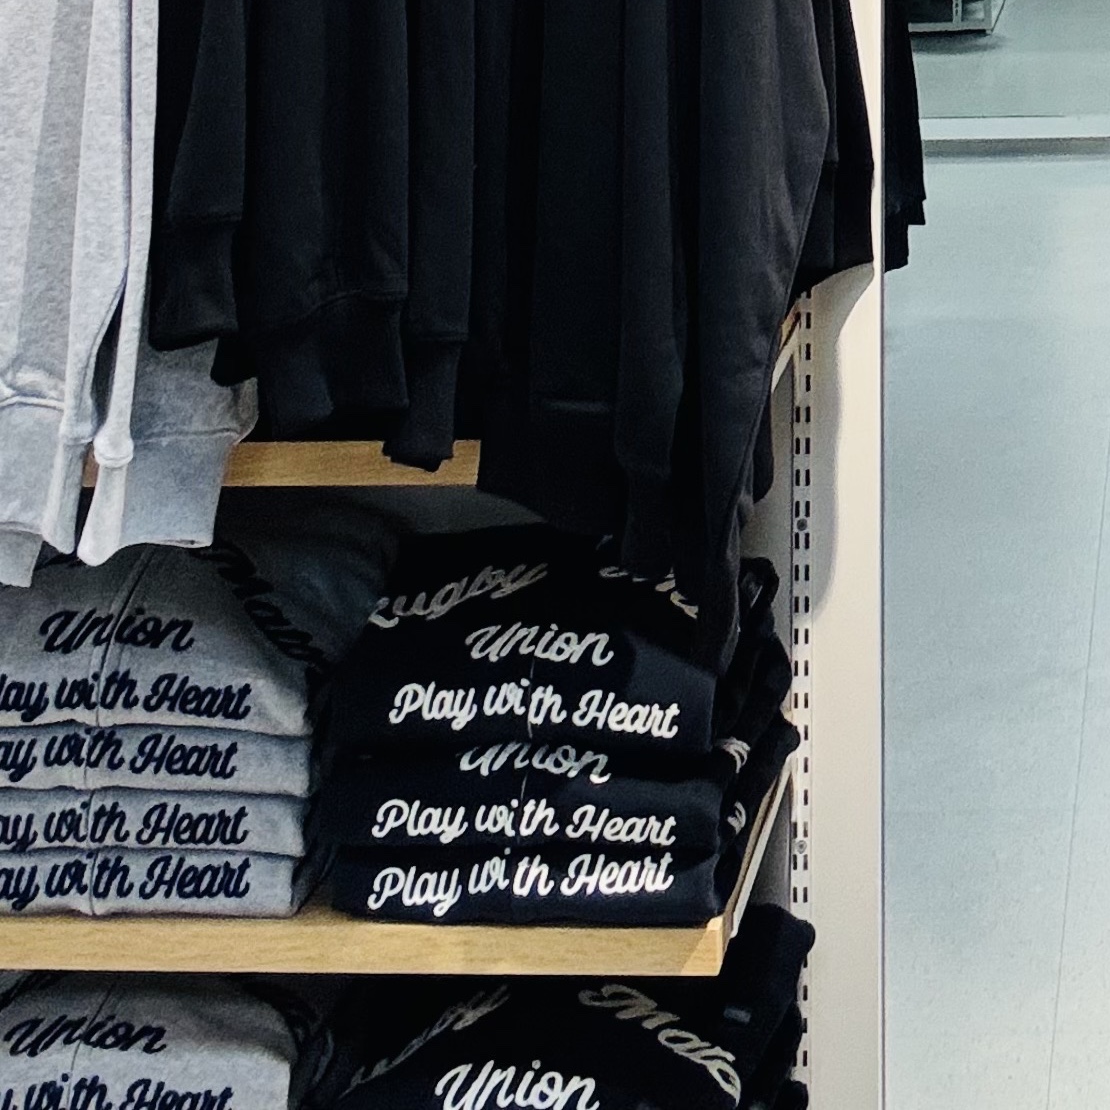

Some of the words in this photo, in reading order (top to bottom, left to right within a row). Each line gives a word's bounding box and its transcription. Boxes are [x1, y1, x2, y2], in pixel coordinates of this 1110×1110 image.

[39, 606, 195, 654] Union
[465, 621, 614, 666] Union
[55, 669, 139, 711] with
[143, 674, 252, 721] Heart
[389, 681, 477, 731] Play
[483, 677, 567, 726] with
[572, 689, 681, 739] Heart
[44, 726, 125, 771] with
[130, 733, 239, 779] Heart
[44, 801, 130, 846] with
[136, 802, 249, 846] Heart
[371, 798, 468, 845] Play
[475, 798, 559, 837] with
[564, 803, 677, 847] Heart
[45, 852, 134, 900] with
[139, 855, 250, 900] Heart
[367, 866, 462, 917] Play
[467, 847, 554, 898] with
[560, 851, 675, 898] Heart
[4, 1014, 167, 1058] Union
[434, 1059, 600, 1110] Union
